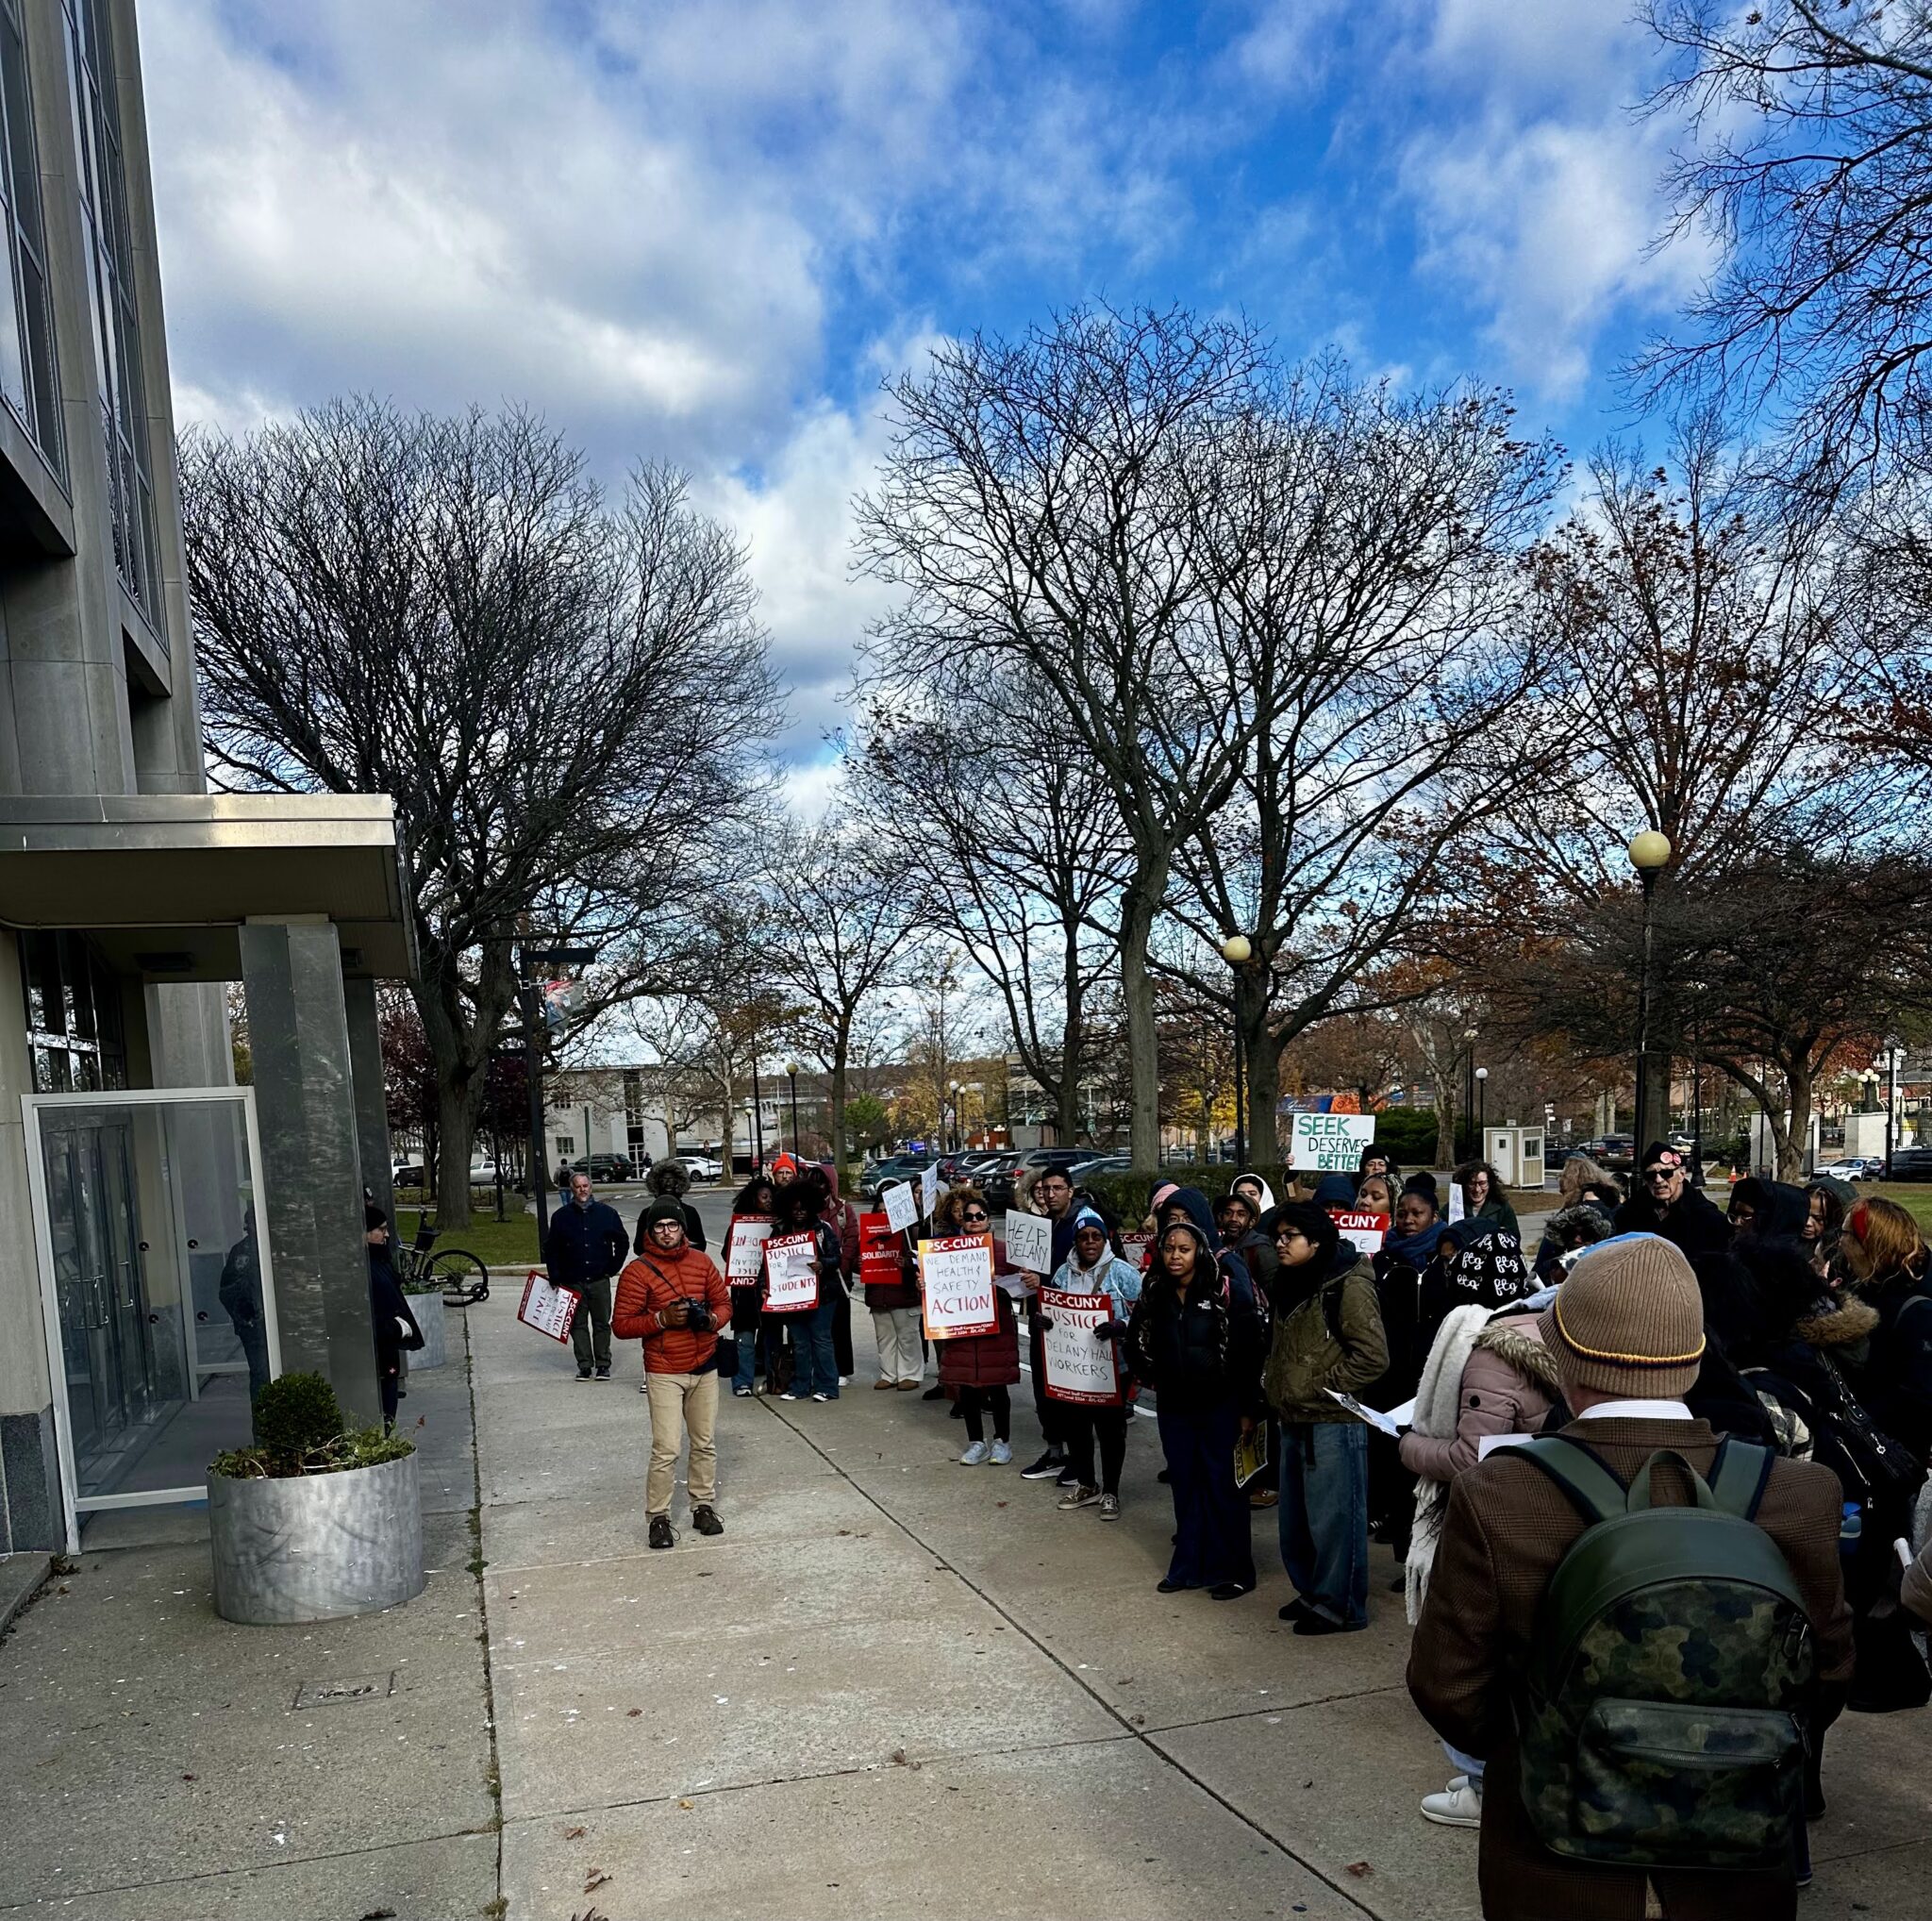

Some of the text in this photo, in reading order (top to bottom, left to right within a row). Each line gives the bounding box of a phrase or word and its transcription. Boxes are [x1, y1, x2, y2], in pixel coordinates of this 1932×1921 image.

[1298, 1115, 1350, 1136] SEEK
[1308, 1137, 1369, 1153] DESERVES
[1334, 1214, 1380, 1228] -CUNY
[1008, 1219, 1047, 1245] HELP
[768, 1233, 809, 1248] PSC-CUNY
[925, 1236, 985, 1251] PSC-CUNY
[768, 1245, 807, 1261] JUSTICE
[861, 1250, 899, 1261] SOLIDARITY
[925, 1251, 989, 1265] WE DEMAND
[1007, 1240, 1048, 1271] DELANY
[937, 1266, 974, 1278] HEALTH
[771, 1278, 816, 1293] STUDENTS
[933, 1279, 979, 1294] SAFETY
[931, 1295, 990, 1315] ACTION
[1043, 1291, 1102, 1309] PSC-CUNY
[562, 1297, 578, 1339] PSC-CUNY
[1044, 1307, 1102, 1329] JUSTICE
[1058, 1328, 1078, 1342] FOR
[1046, 1338, 1113, 1361] DELANY HALL
[1049, 1357, 1108, 1380] WORKERS
